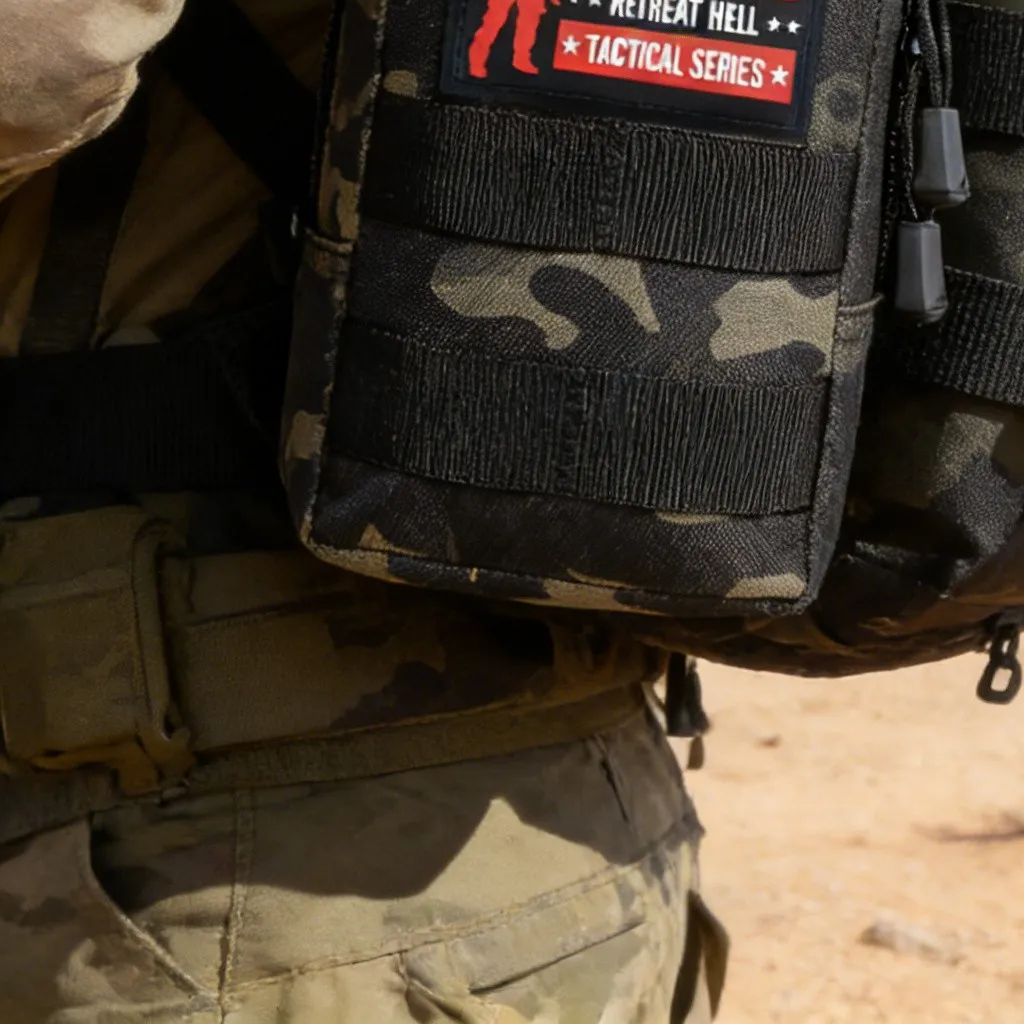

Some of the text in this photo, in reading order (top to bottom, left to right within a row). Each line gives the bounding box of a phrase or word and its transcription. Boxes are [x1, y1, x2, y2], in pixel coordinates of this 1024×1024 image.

[707, 0, 759, 37] HELL
[585, 34, 767, 89] TACTICAL SERIES
